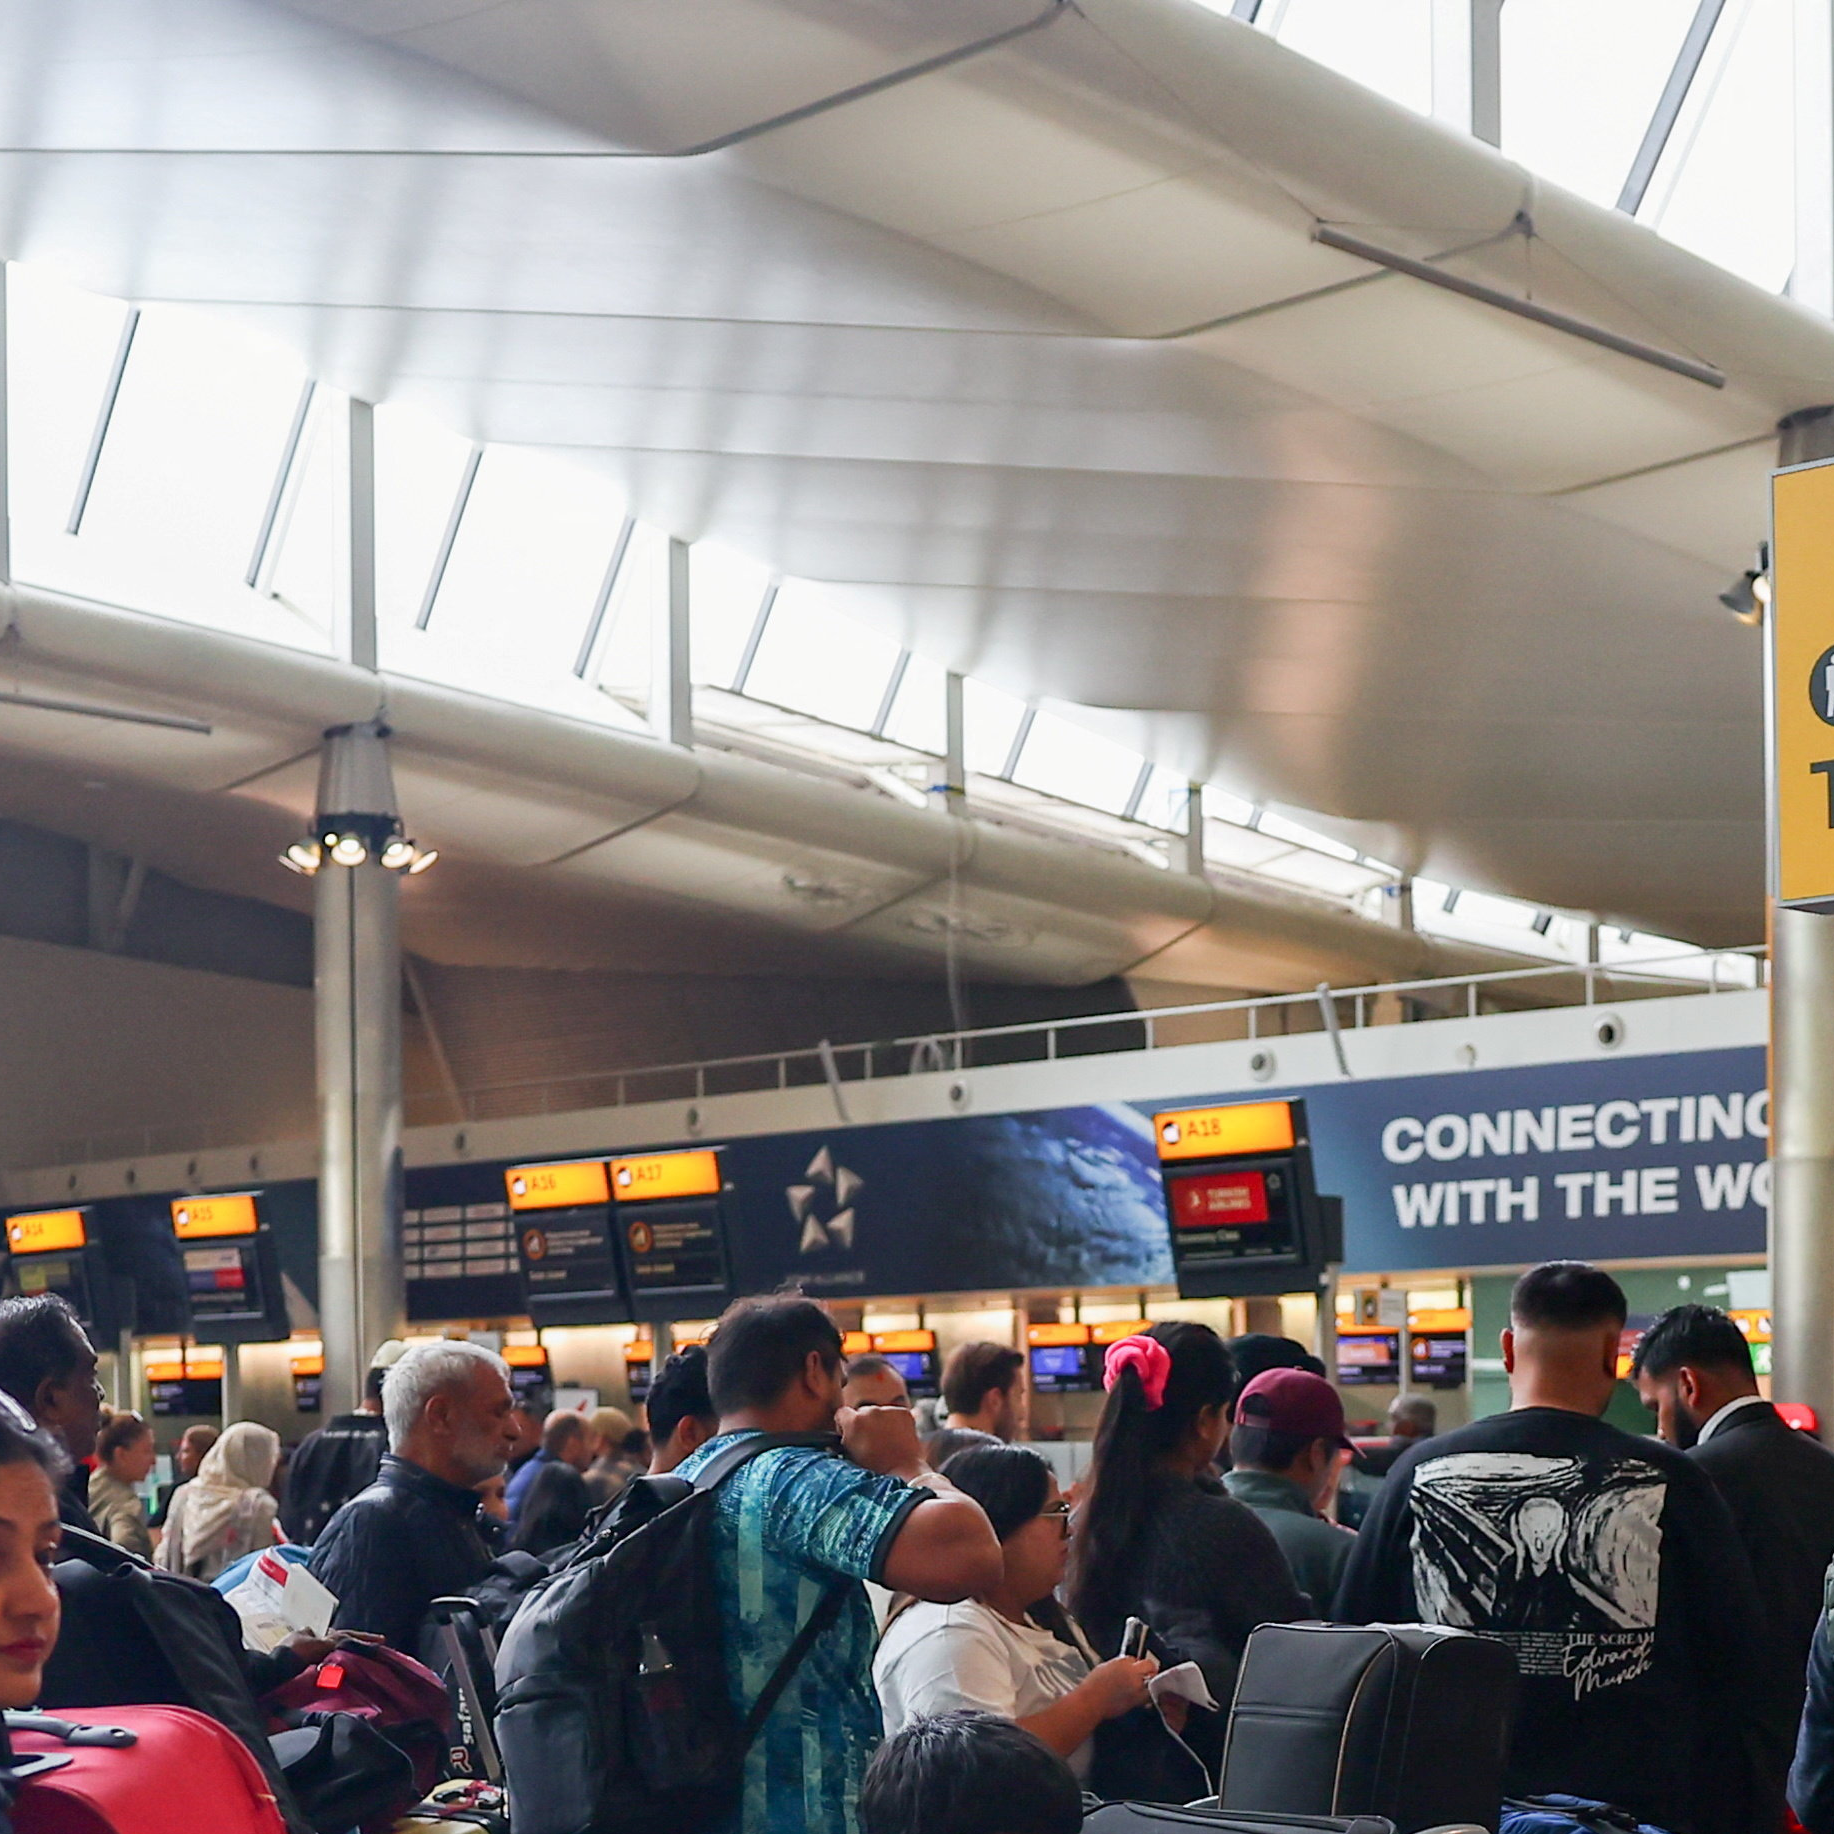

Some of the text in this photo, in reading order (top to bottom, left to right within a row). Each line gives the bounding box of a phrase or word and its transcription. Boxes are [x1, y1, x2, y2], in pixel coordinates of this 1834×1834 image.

[1188, 1118, 1221, 1137] A18
[1392, 1175, 1539, 1229] WITH
[1554, 1167, 1679, 1224] THE
[1567, 1632, 1654, 1645] THE SCREAM
[1562, 1640, 1651, 1677] Edward
[1574, 1659, 1652, 1700] Munch
